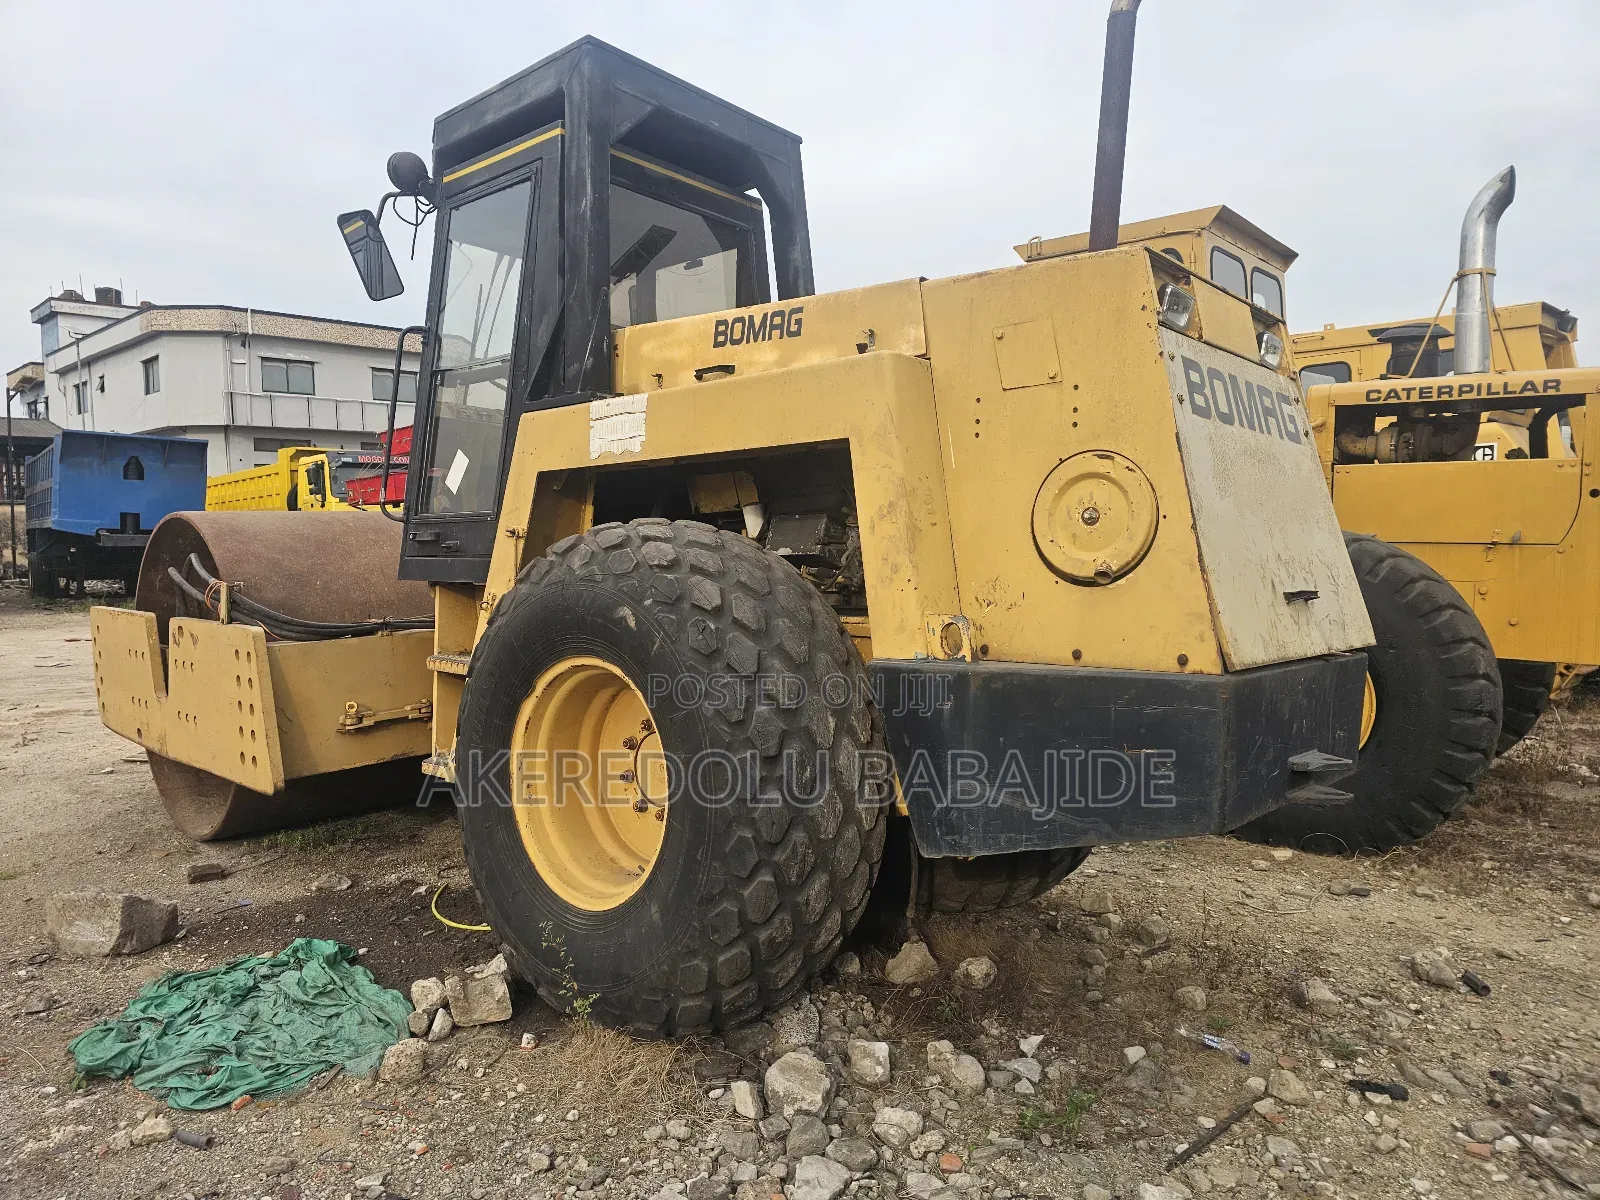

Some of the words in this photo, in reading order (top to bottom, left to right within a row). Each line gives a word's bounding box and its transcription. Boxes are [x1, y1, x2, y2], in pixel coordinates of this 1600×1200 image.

[713, 307, 804, 348] BOMAG
[1182, 355, 1302, 445] BOMAG
[1365, 379, 1562, 403] CATERPILLAR
